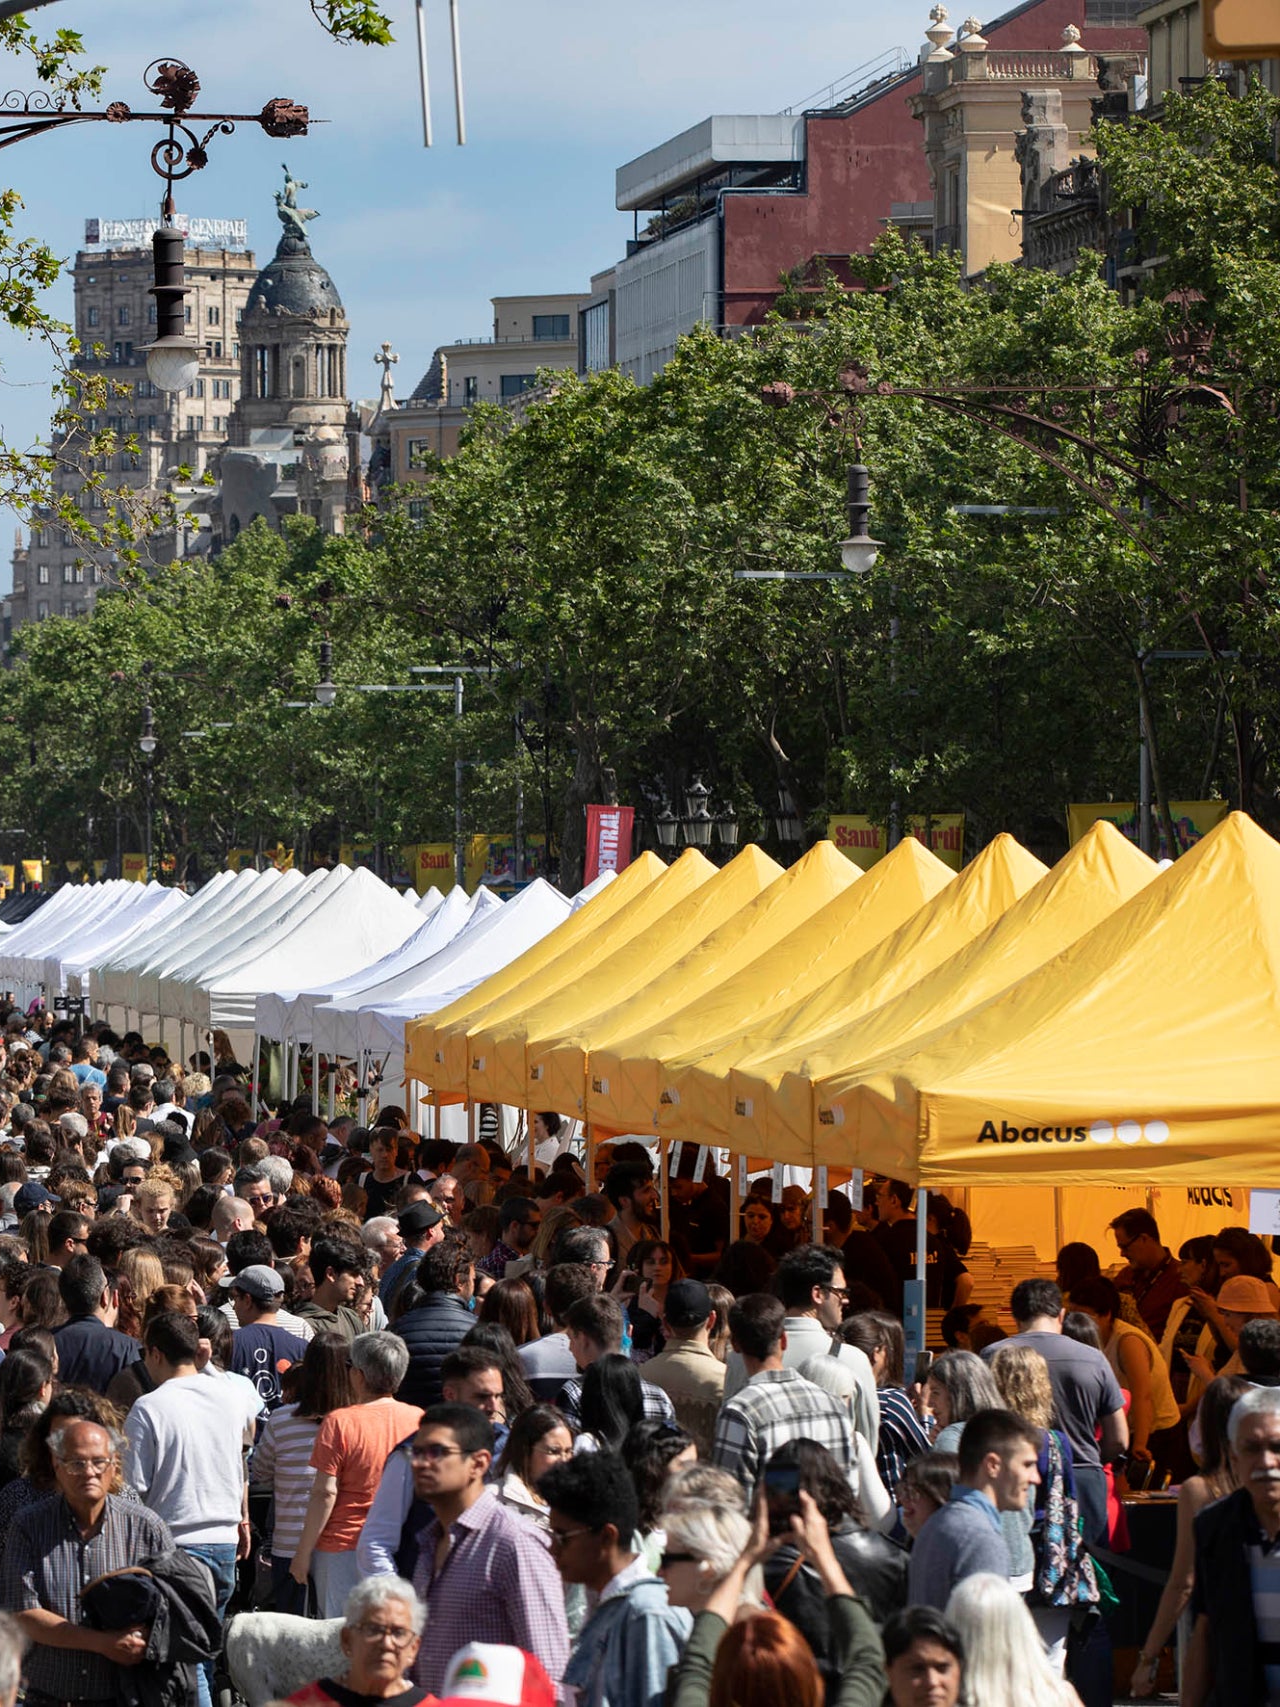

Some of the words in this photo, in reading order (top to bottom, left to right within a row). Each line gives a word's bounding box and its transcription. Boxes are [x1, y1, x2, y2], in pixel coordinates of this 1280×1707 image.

[598, 811, 620, 876] ENTRAL
[834, 825, 880, 849] Sant
[420, 852, 450, 869] Sant
[977, 1119, 1087, 1144] Abacus
